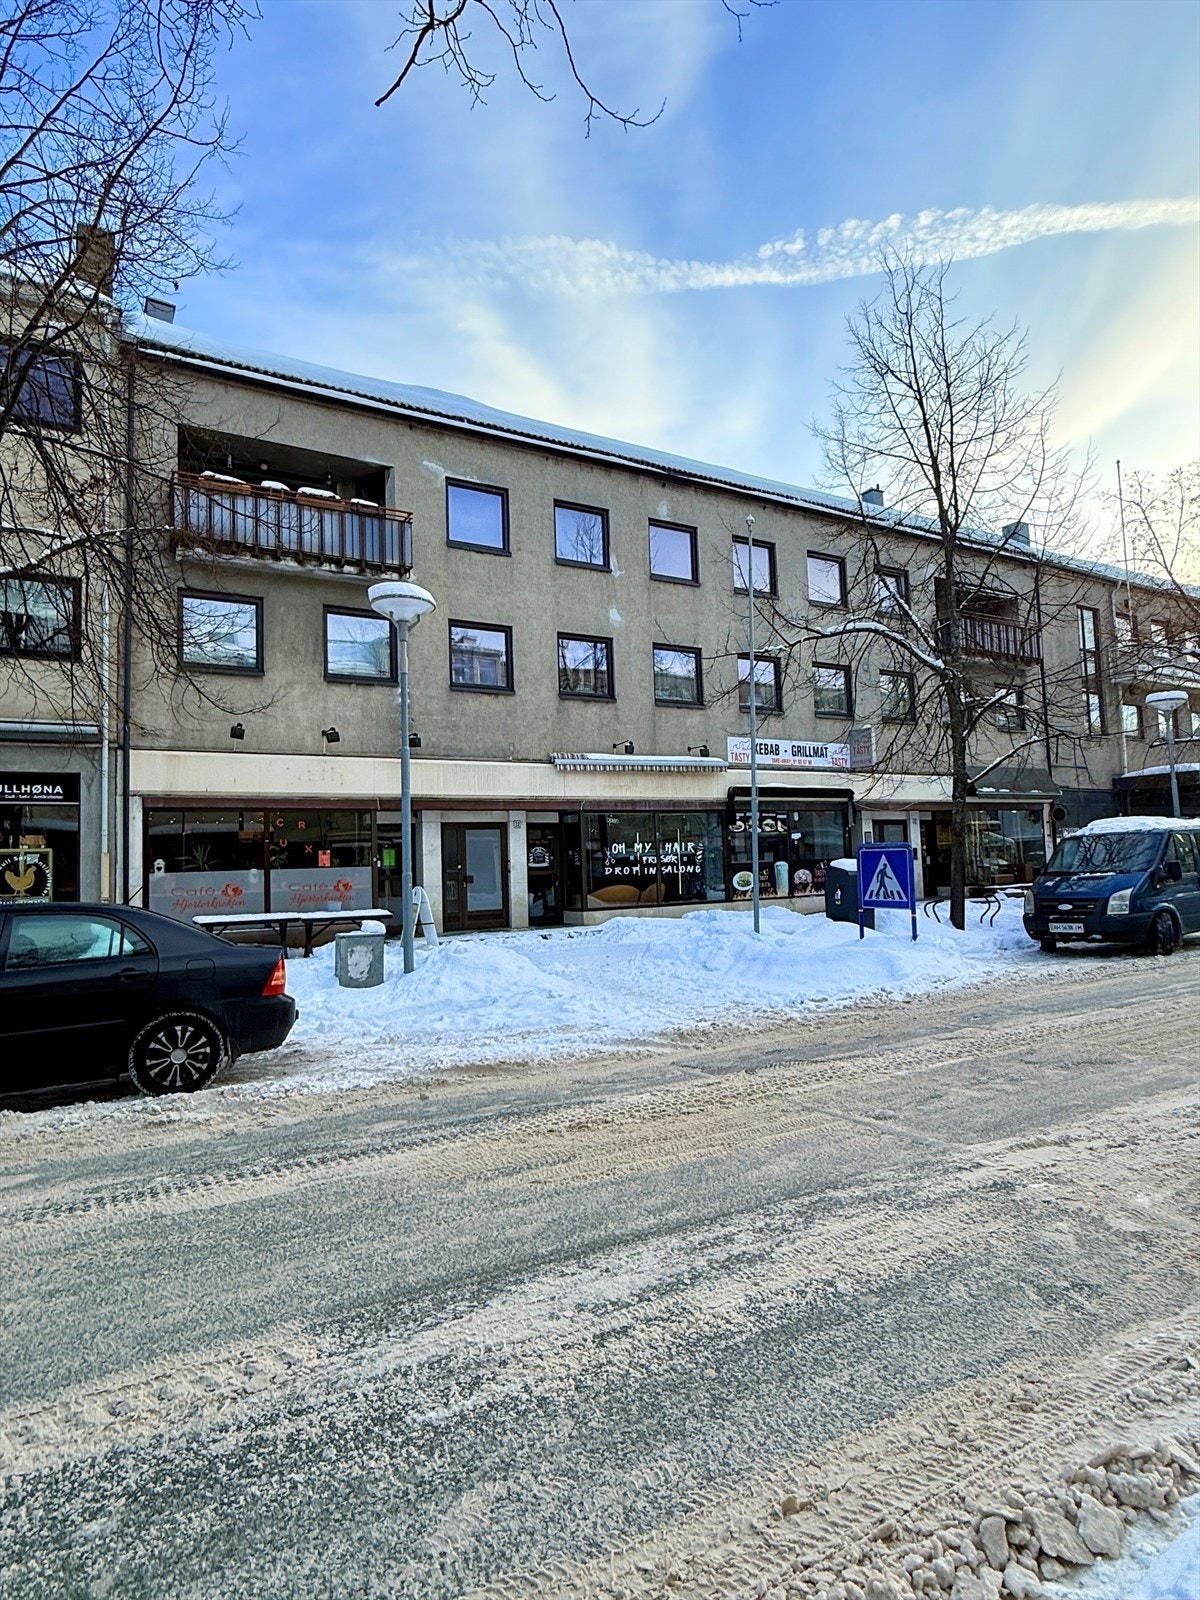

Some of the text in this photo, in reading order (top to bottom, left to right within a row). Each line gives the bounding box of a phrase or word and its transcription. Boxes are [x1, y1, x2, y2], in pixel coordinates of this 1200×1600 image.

[731, 752, 750, 763] TASTY
[791, 745, 829, 759] GRILLMAT
[831, 757, 848, 767] TASTY
[611, 842, 695, 855] OH MY HAIR
[644, 867, 657, 875] IN
[661, 865, 701, 874] SALONG
